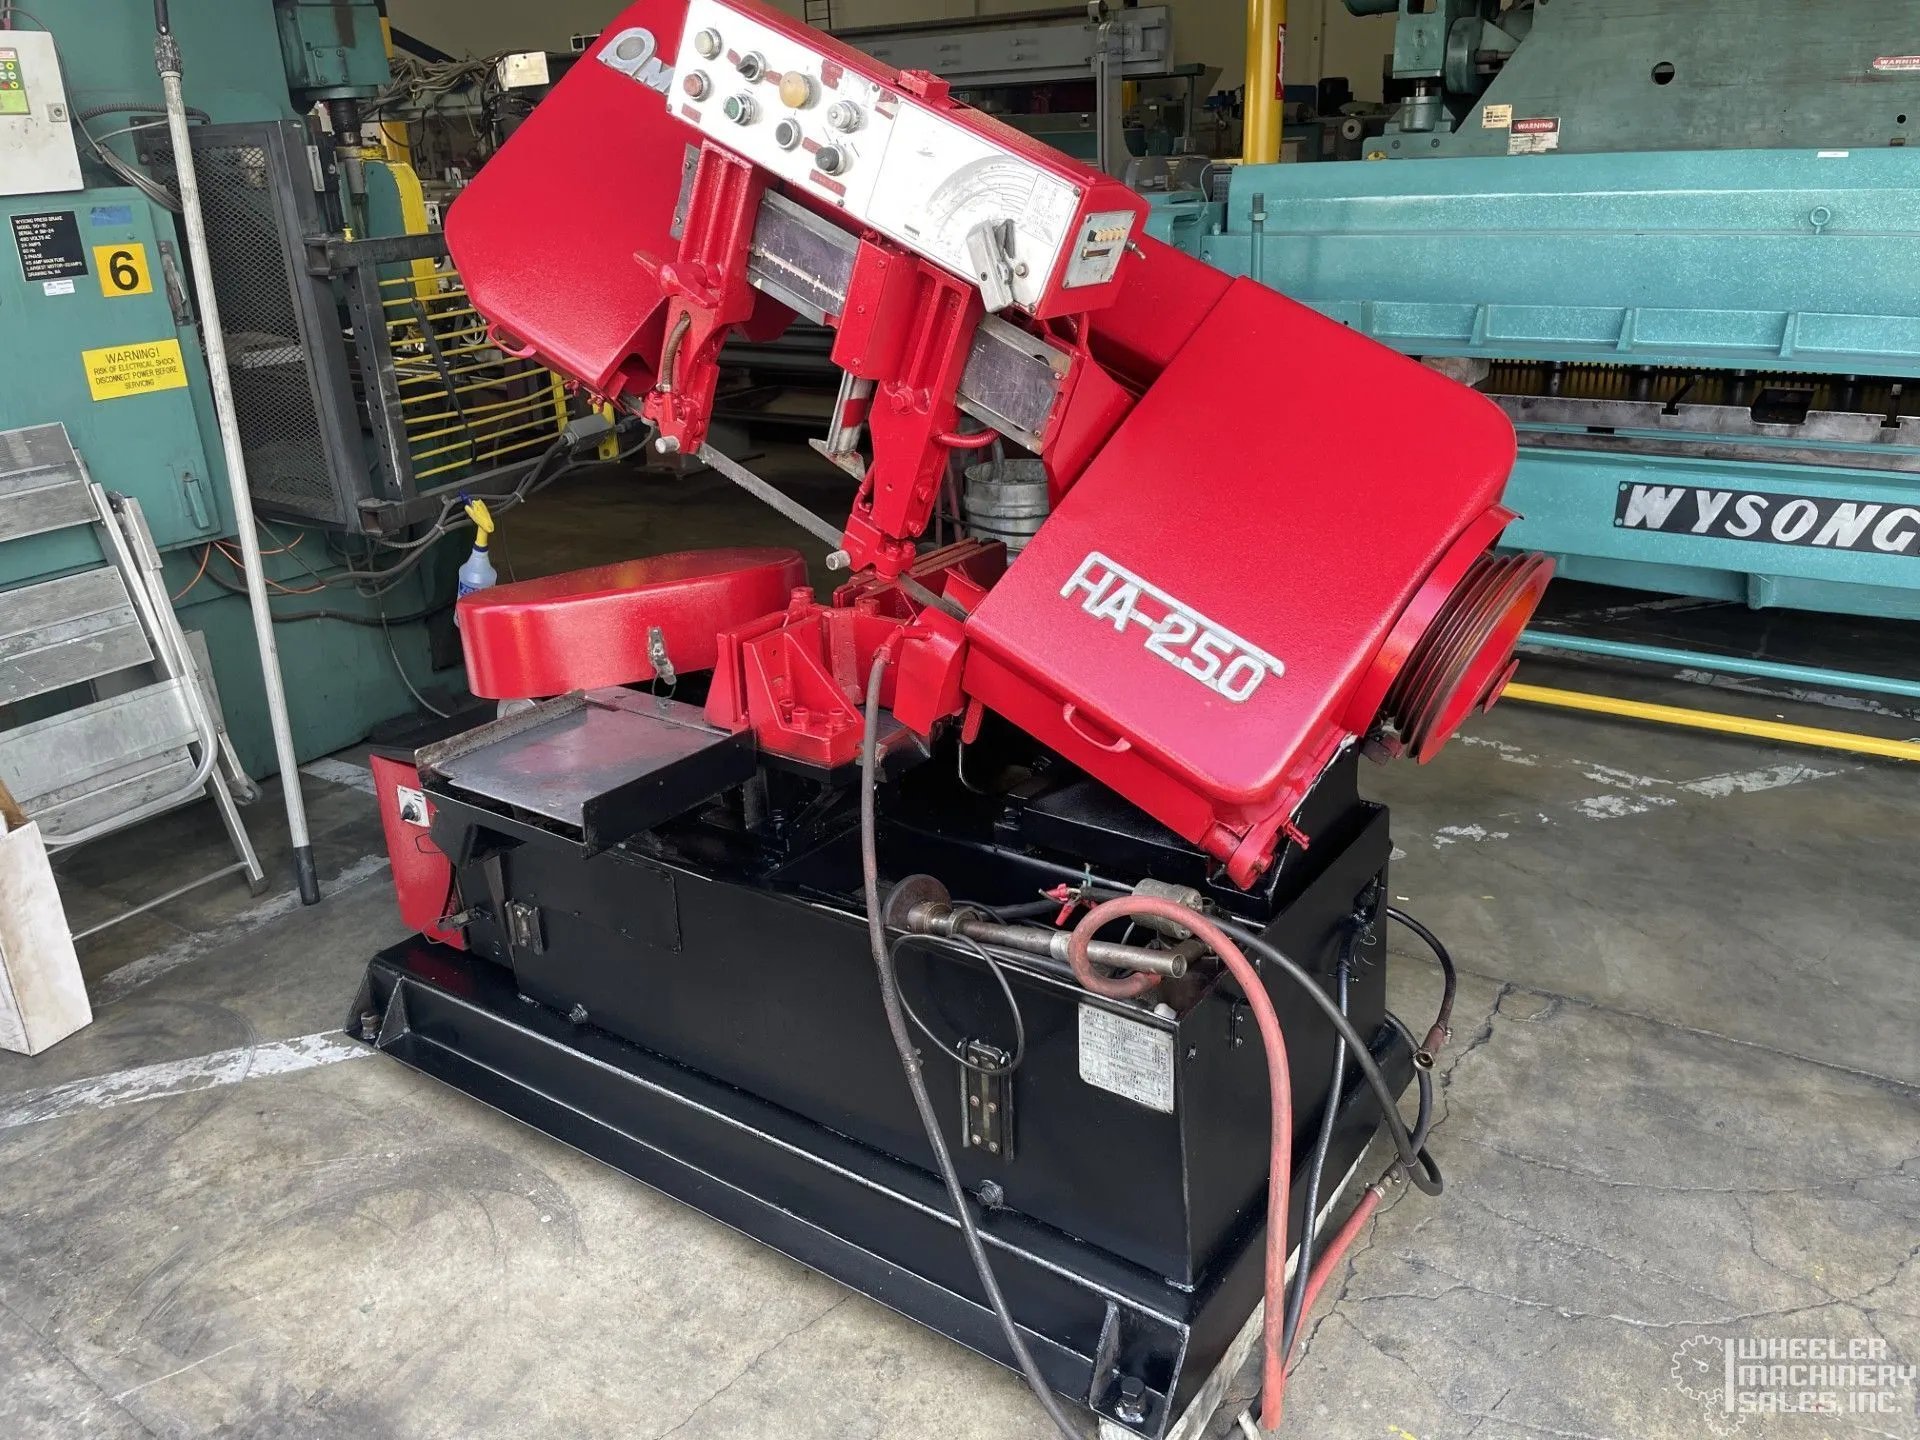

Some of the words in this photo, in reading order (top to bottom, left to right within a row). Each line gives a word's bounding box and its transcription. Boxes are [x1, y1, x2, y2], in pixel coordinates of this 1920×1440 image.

[1517, 122, 1554, 130] WARNING
[109, 250, 139, 291] 6
[105, 347, 160, 364] WARNING!
[93, 367, 107, 376] RISK
[108, 365, 117, 373] OF
[118, 361, 154, 372] ELECTRICAL
[155, 357, 175, 366] SHOCK
[95, 373, 131, 385] DISCONNECT
[132, 369, 154, 379] POWER
[155, 366, 178, 376] BEFORE
[124, 379, 155, 390] SERVICING
[1623, 484, 1920, 552] WYSONG
[1059, 550, 1286, 703] HA-250
